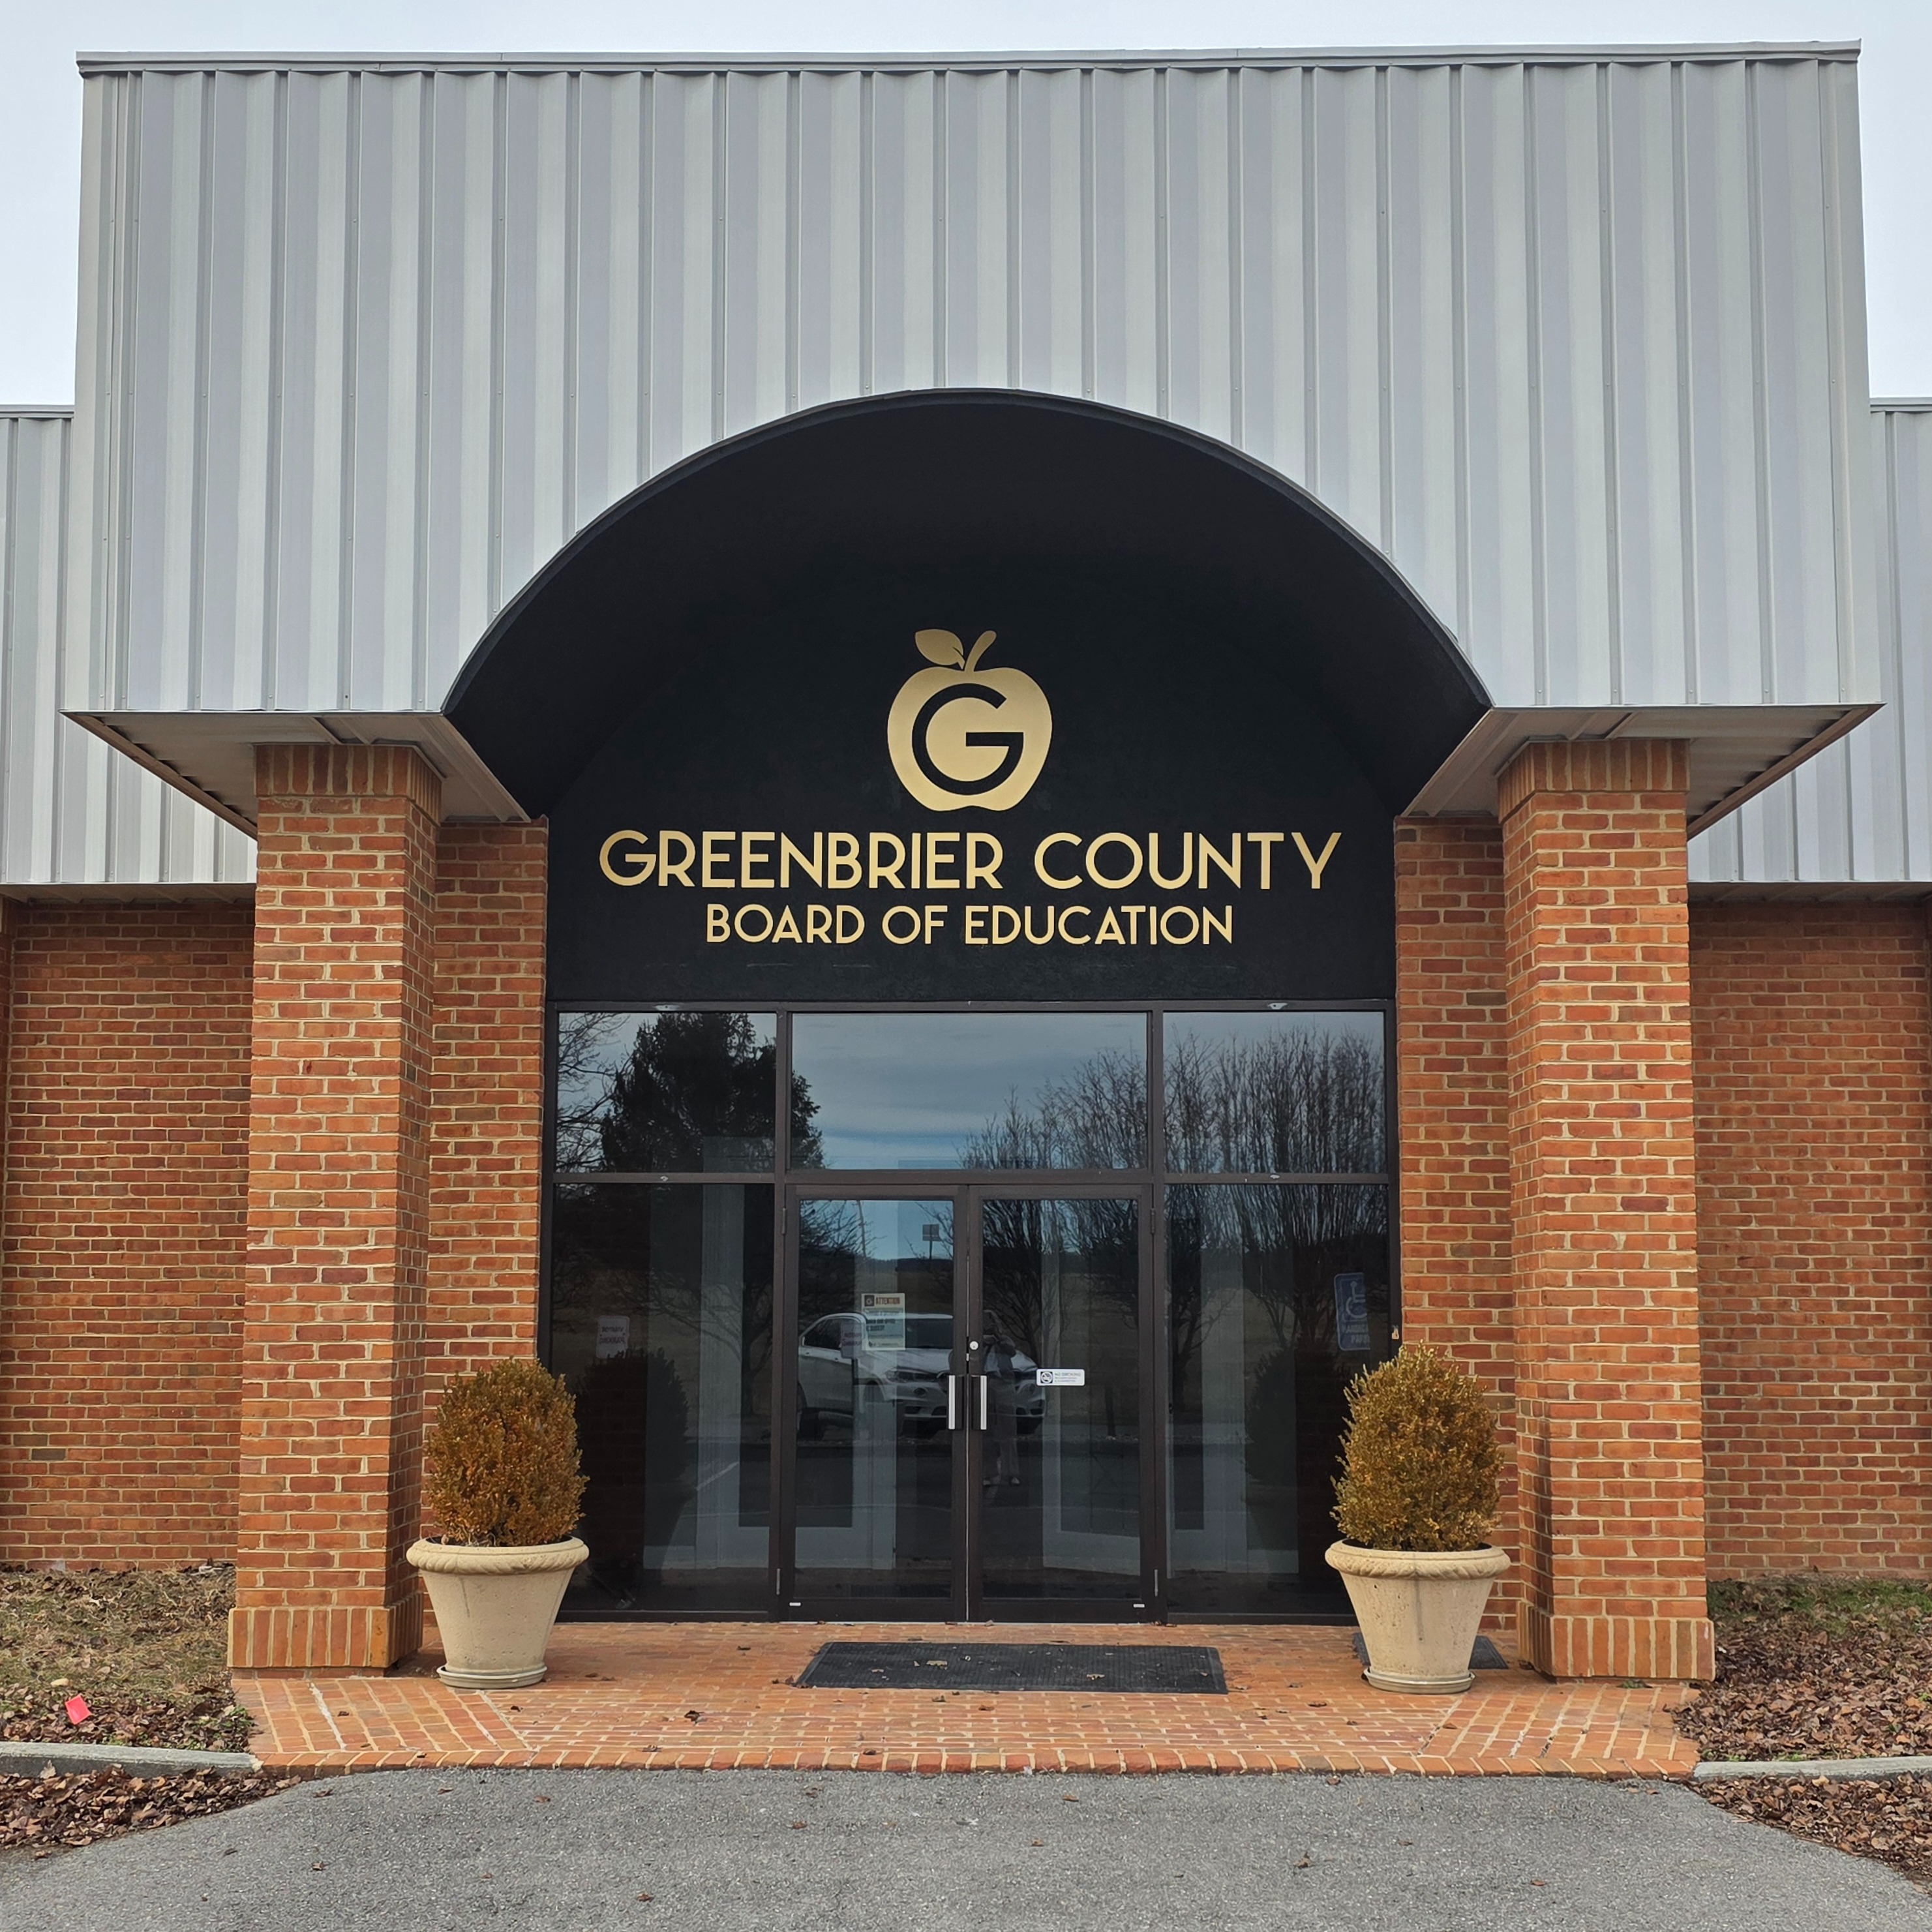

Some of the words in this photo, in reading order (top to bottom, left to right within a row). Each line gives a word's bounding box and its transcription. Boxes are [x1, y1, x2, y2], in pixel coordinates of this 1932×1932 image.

[912, 683, 1023, 795] G
[599, 830, 1003, 889] GREENBRIER
[1034, 832, 1342, 890] COUNTY
[706, 903, 865, 944] BOARD
[882, 905, 948, 944] OF
[965, 905, 1232, 945] EDUCATION
